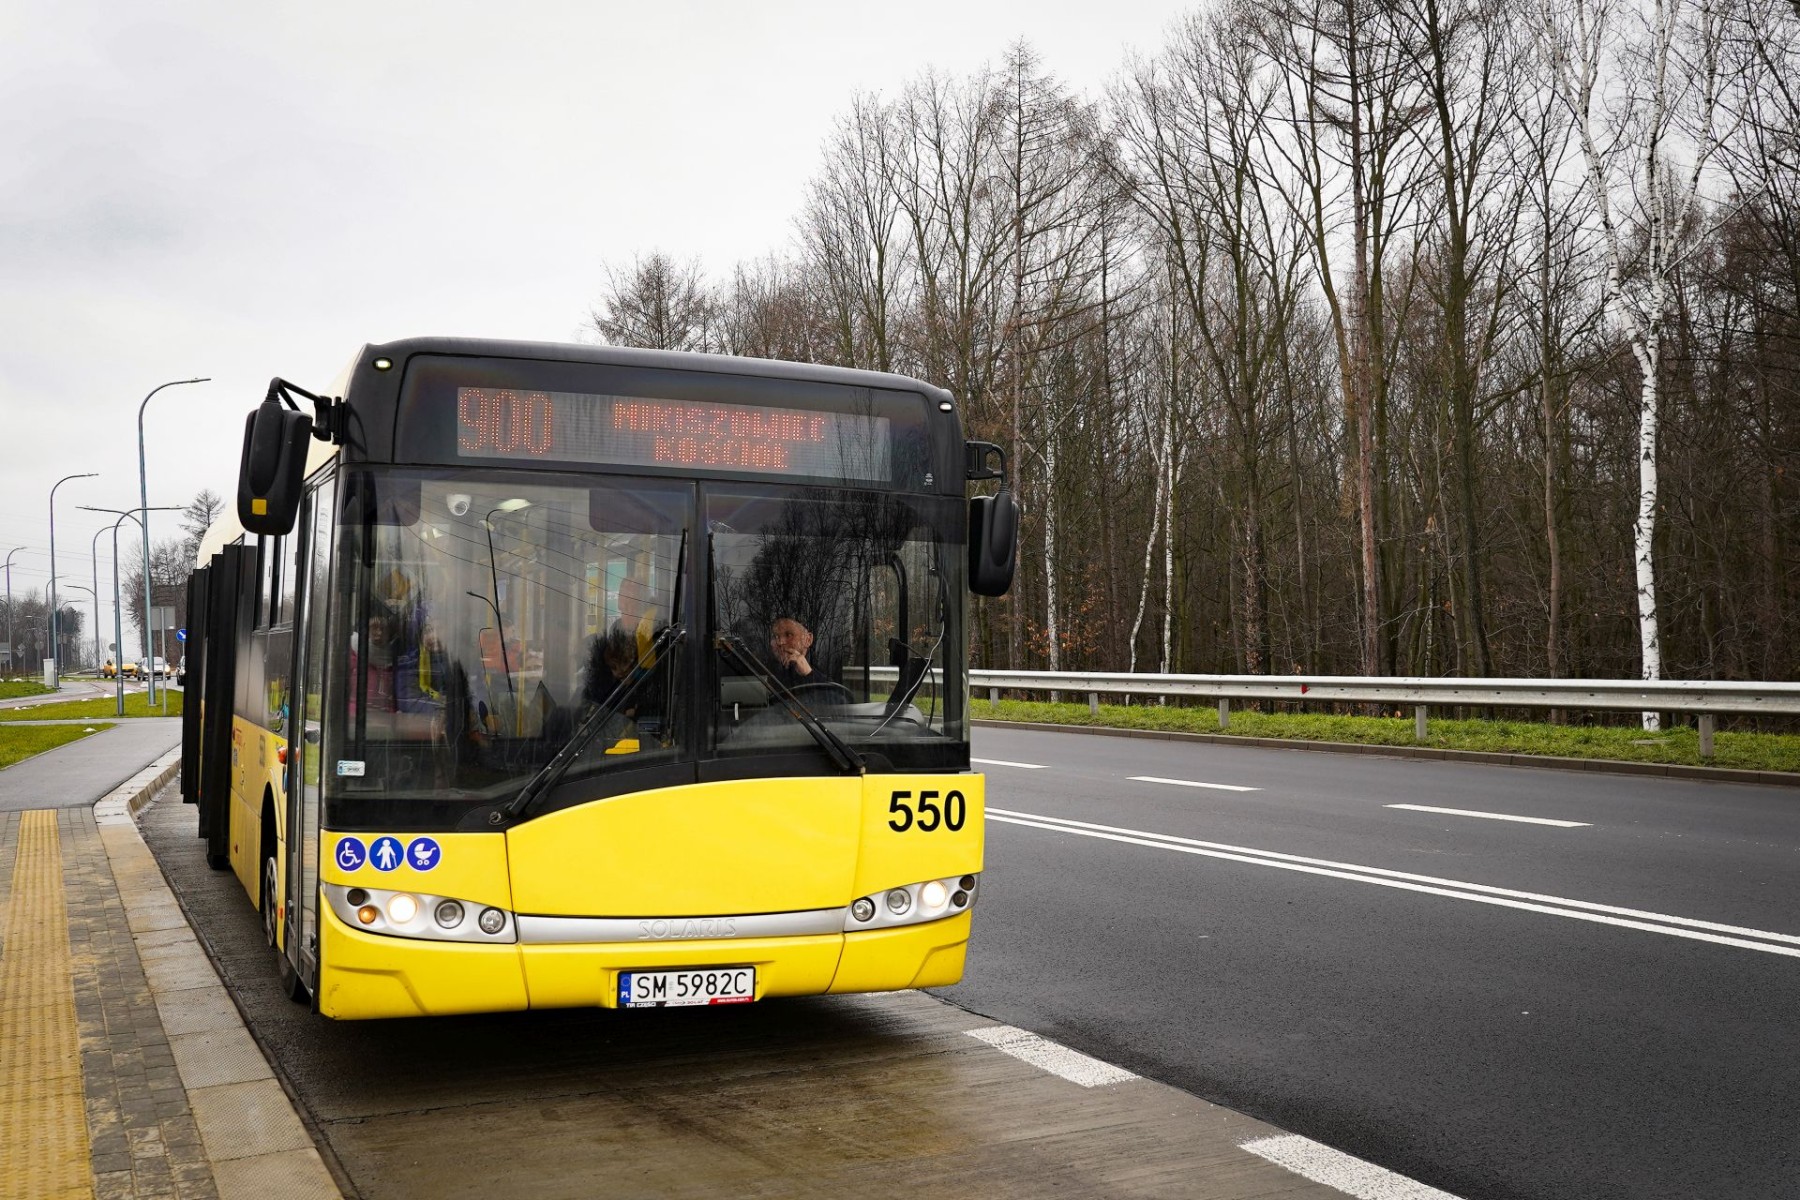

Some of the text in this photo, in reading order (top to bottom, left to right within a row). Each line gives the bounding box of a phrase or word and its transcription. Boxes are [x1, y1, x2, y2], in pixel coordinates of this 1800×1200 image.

[459, 390, 552, 453] 900
[614, 403, 825, 441] NIKISZOWIEC
[888, 790, 966, 832] 550
[638, 918, 736, 938] SOLARIS
[637, 971, 747, 999] SM 5982C
